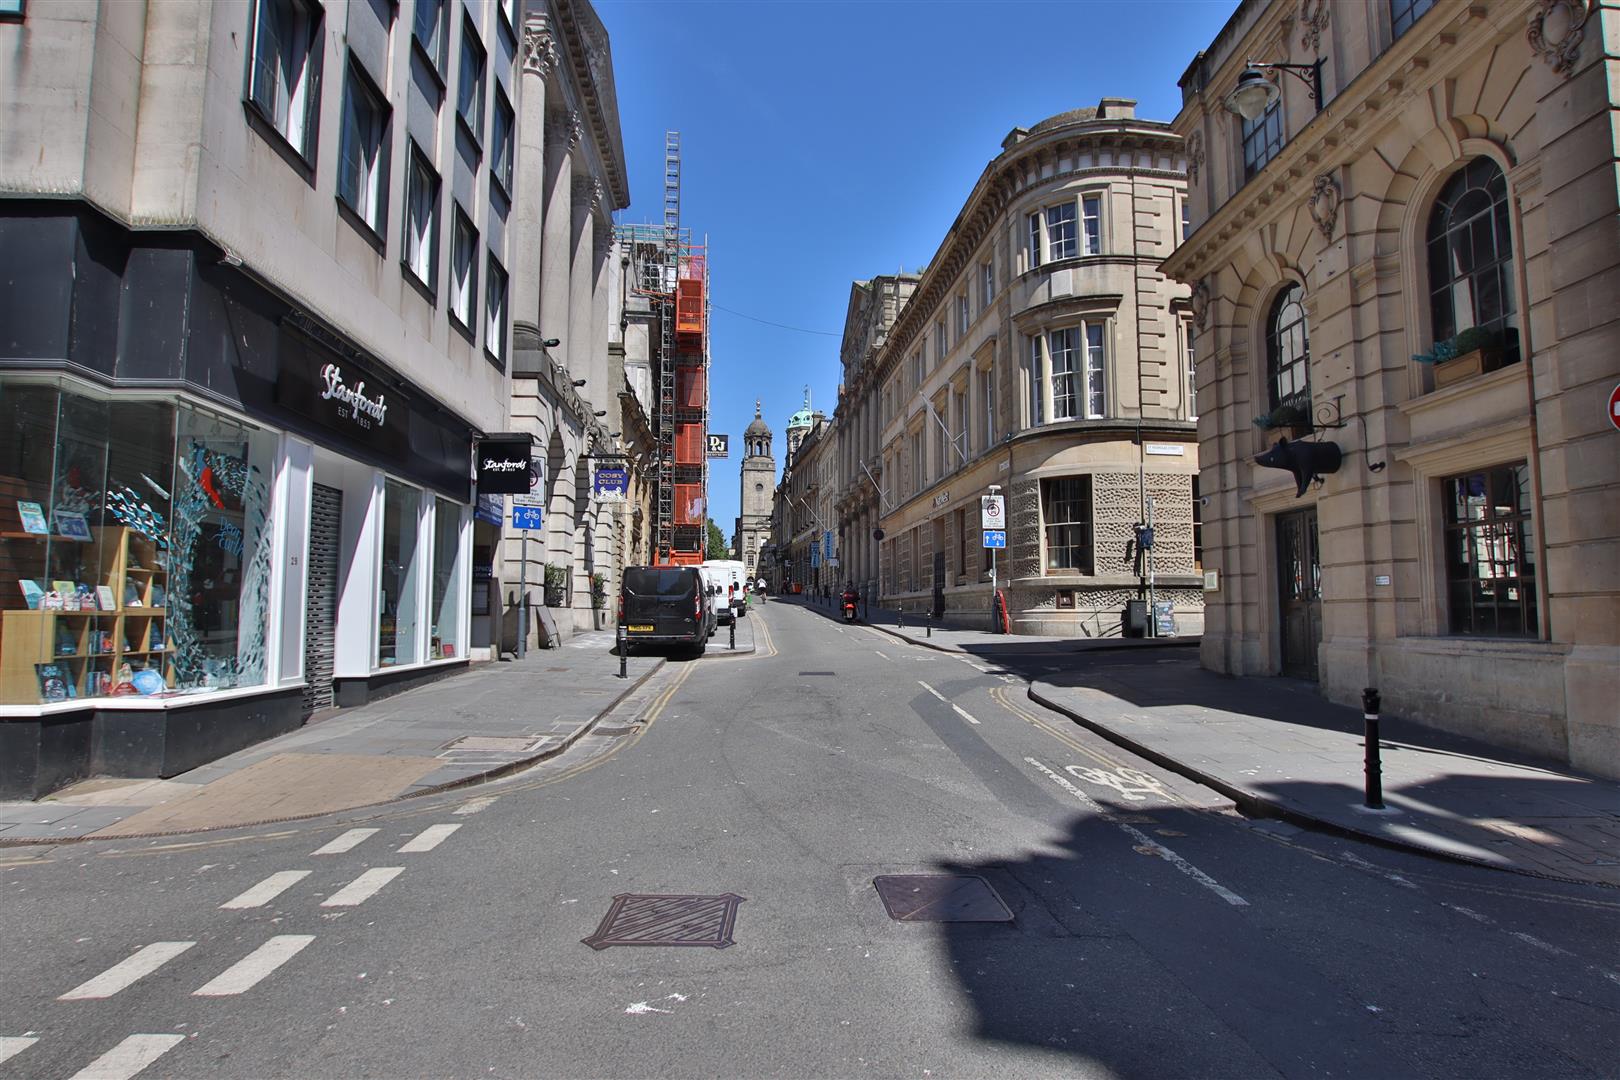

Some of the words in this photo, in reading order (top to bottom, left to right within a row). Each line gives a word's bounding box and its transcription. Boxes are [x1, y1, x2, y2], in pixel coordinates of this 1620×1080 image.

[321, 363, 388, 426] Stanfords
[338, 406, 349, 419] EST
[357, 416, 371, 430] 1853
[482, 458, 527, 472] Stanfords
